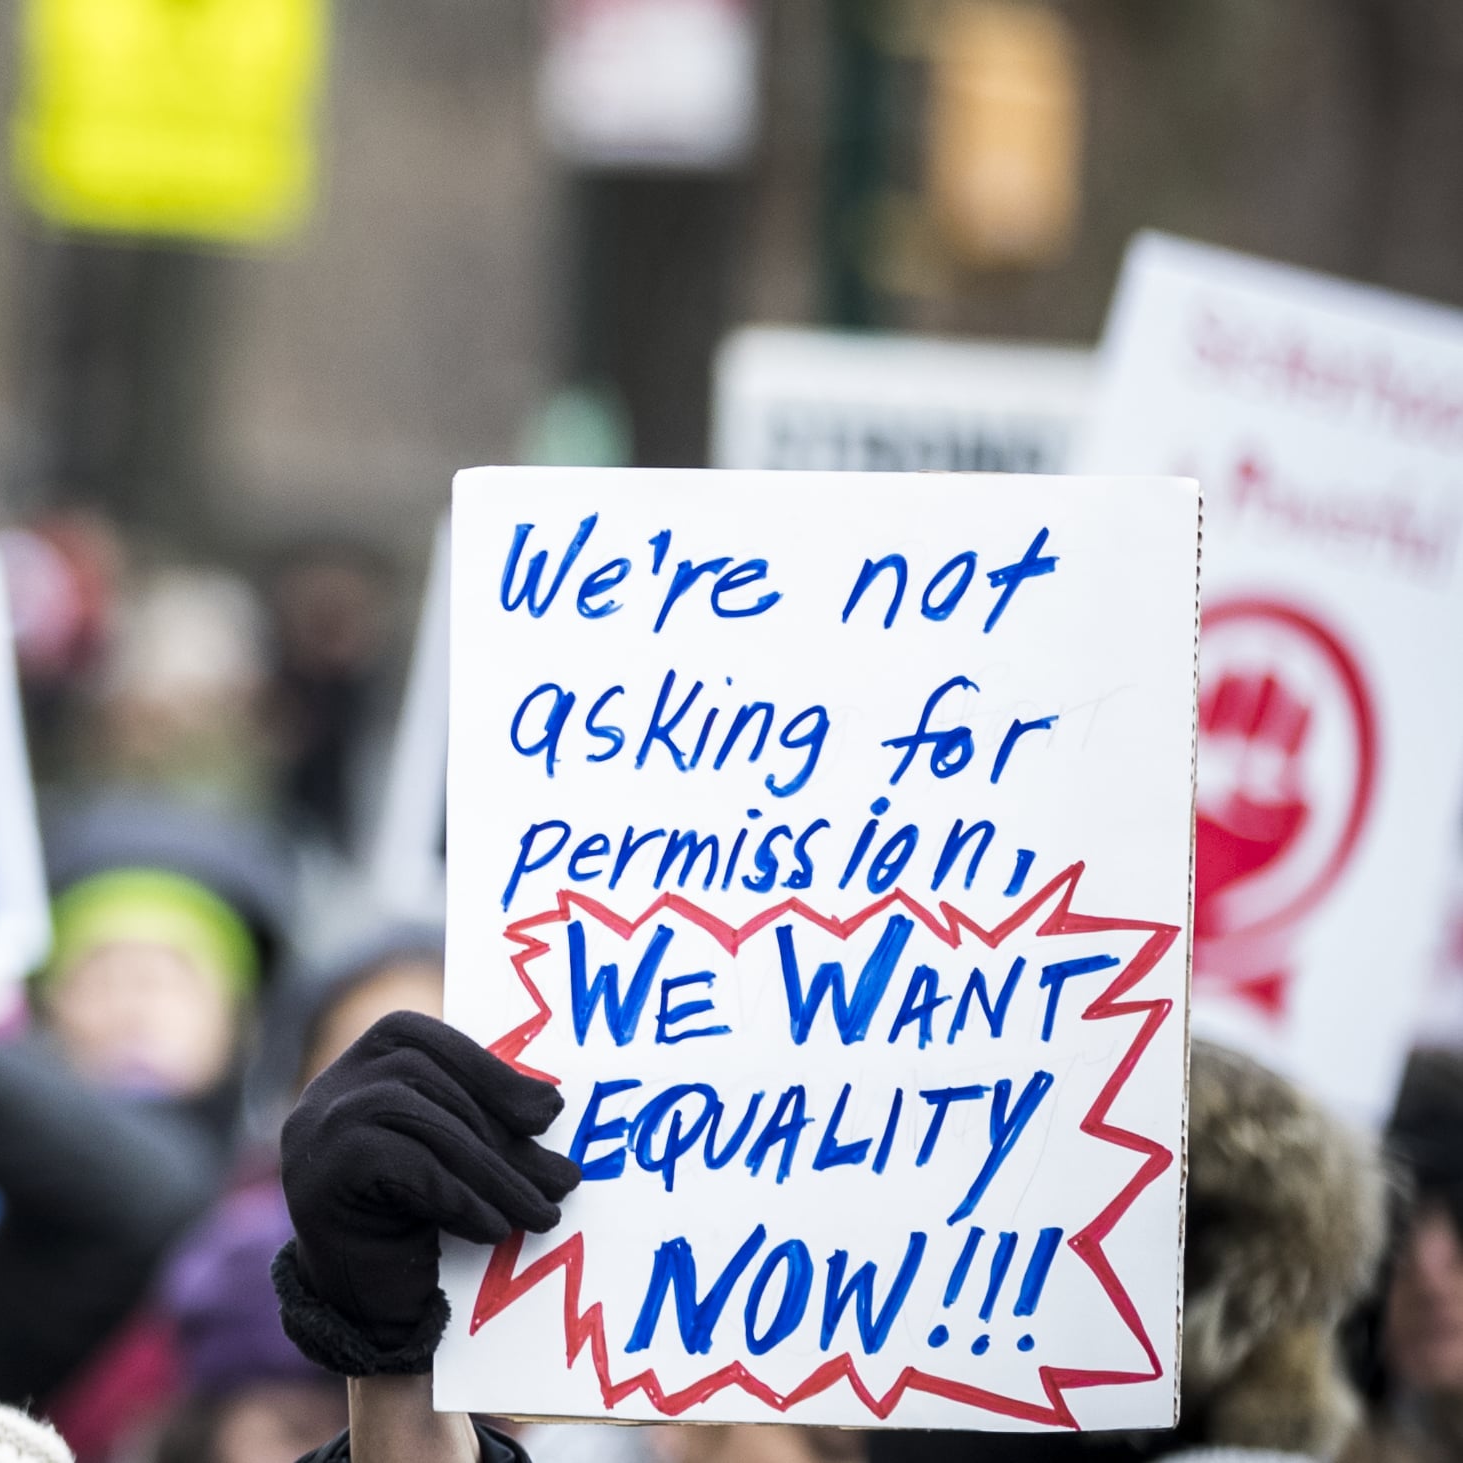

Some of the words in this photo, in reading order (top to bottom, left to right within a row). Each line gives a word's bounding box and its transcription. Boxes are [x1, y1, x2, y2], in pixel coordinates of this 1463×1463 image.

[500, 512, 783, 634] We're
[841, 527, 1059, 634] not
[509, 668, 830, 797] asking
[881, 675, 1058, 786] for
[501, 796, 1036, 913] permission,
[566, 920, 732, 1047] WE
[775, 913, 1121, 1050] WANT
[566, 1070, 1054, 1226] EQUALITY
[624, 1224, 1064, 1356] NOW!!!
